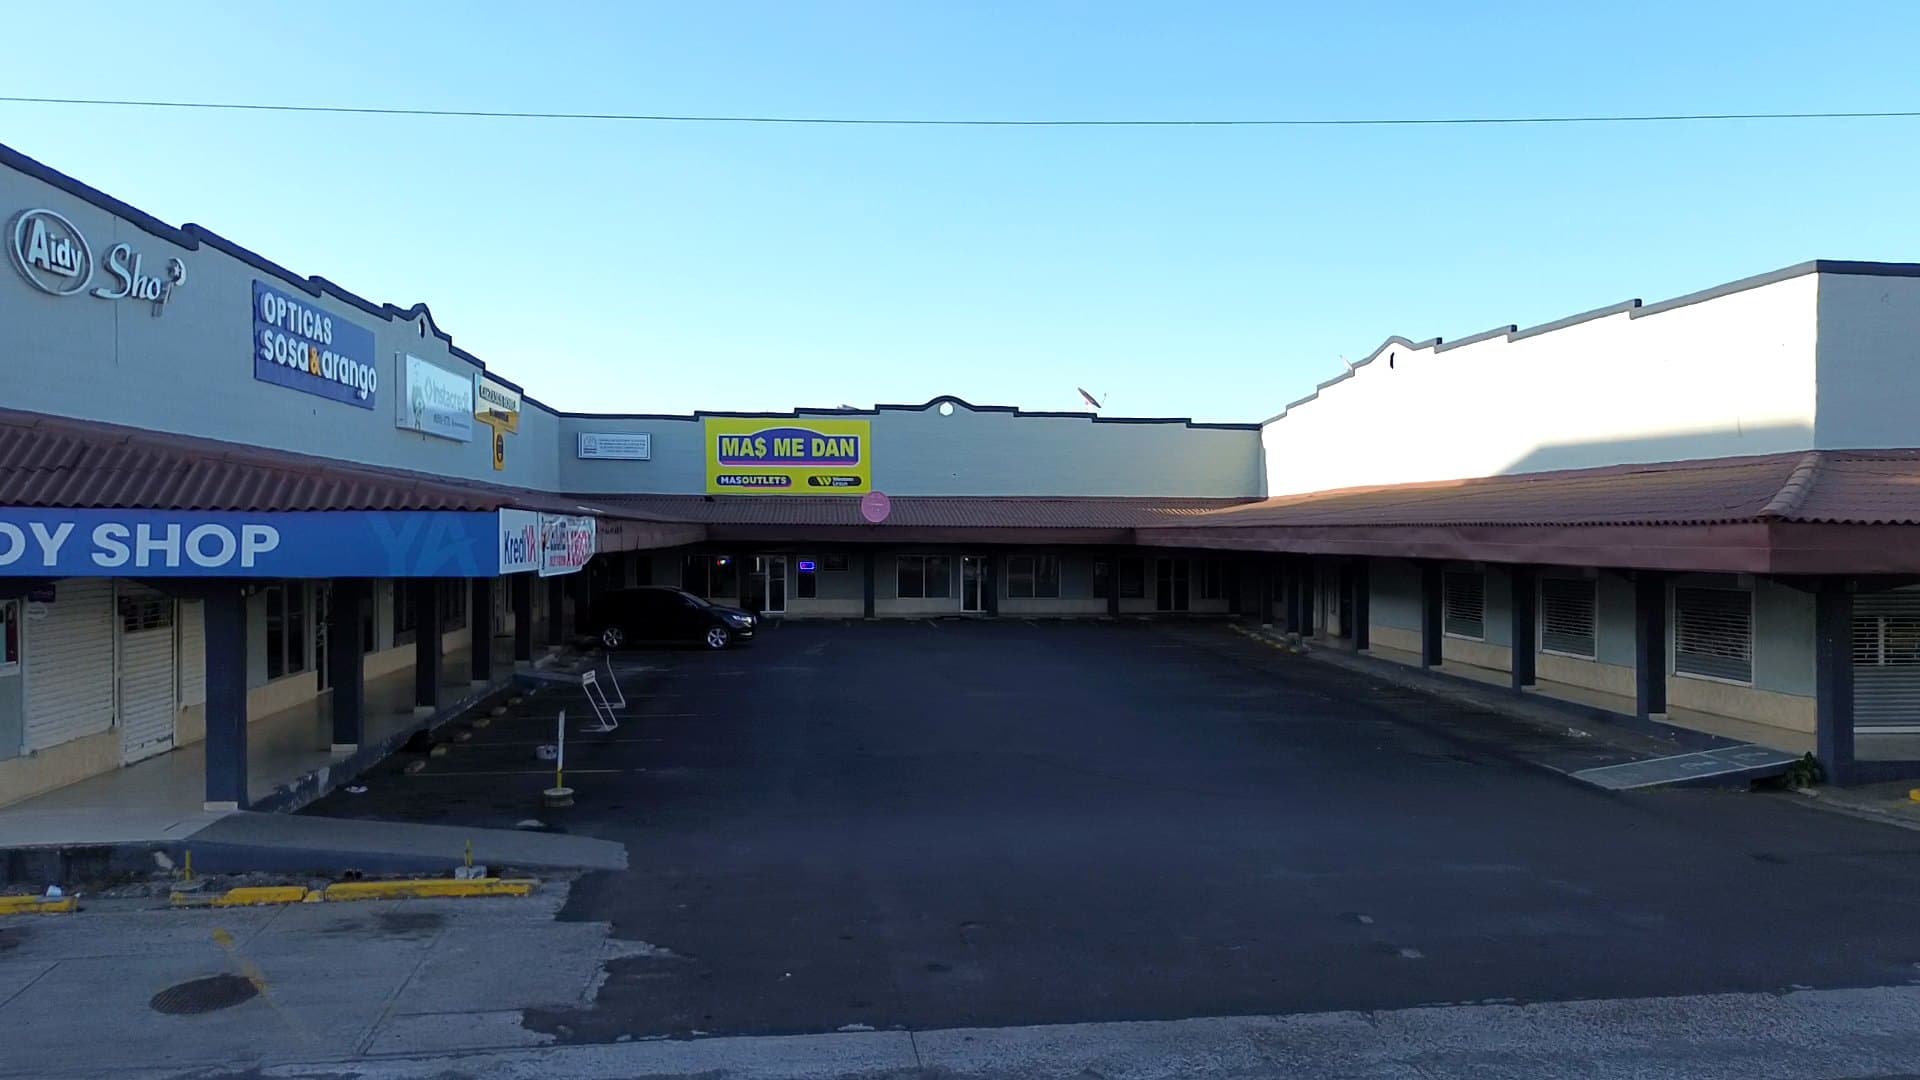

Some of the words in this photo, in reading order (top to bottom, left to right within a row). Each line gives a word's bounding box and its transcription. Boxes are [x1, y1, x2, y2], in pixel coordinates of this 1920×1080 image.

[28, 219, 82, 276] Aidy
[264, 292, 332, 345] OPTICAS
[722, 437, 767, 458] MA$
[774, 438, 805, 457] ME
[812, 439, 855, 457] DAN
[721, 476, 787, 485] MASOUTLETS
[91, 523, 280, 568] SHOP
